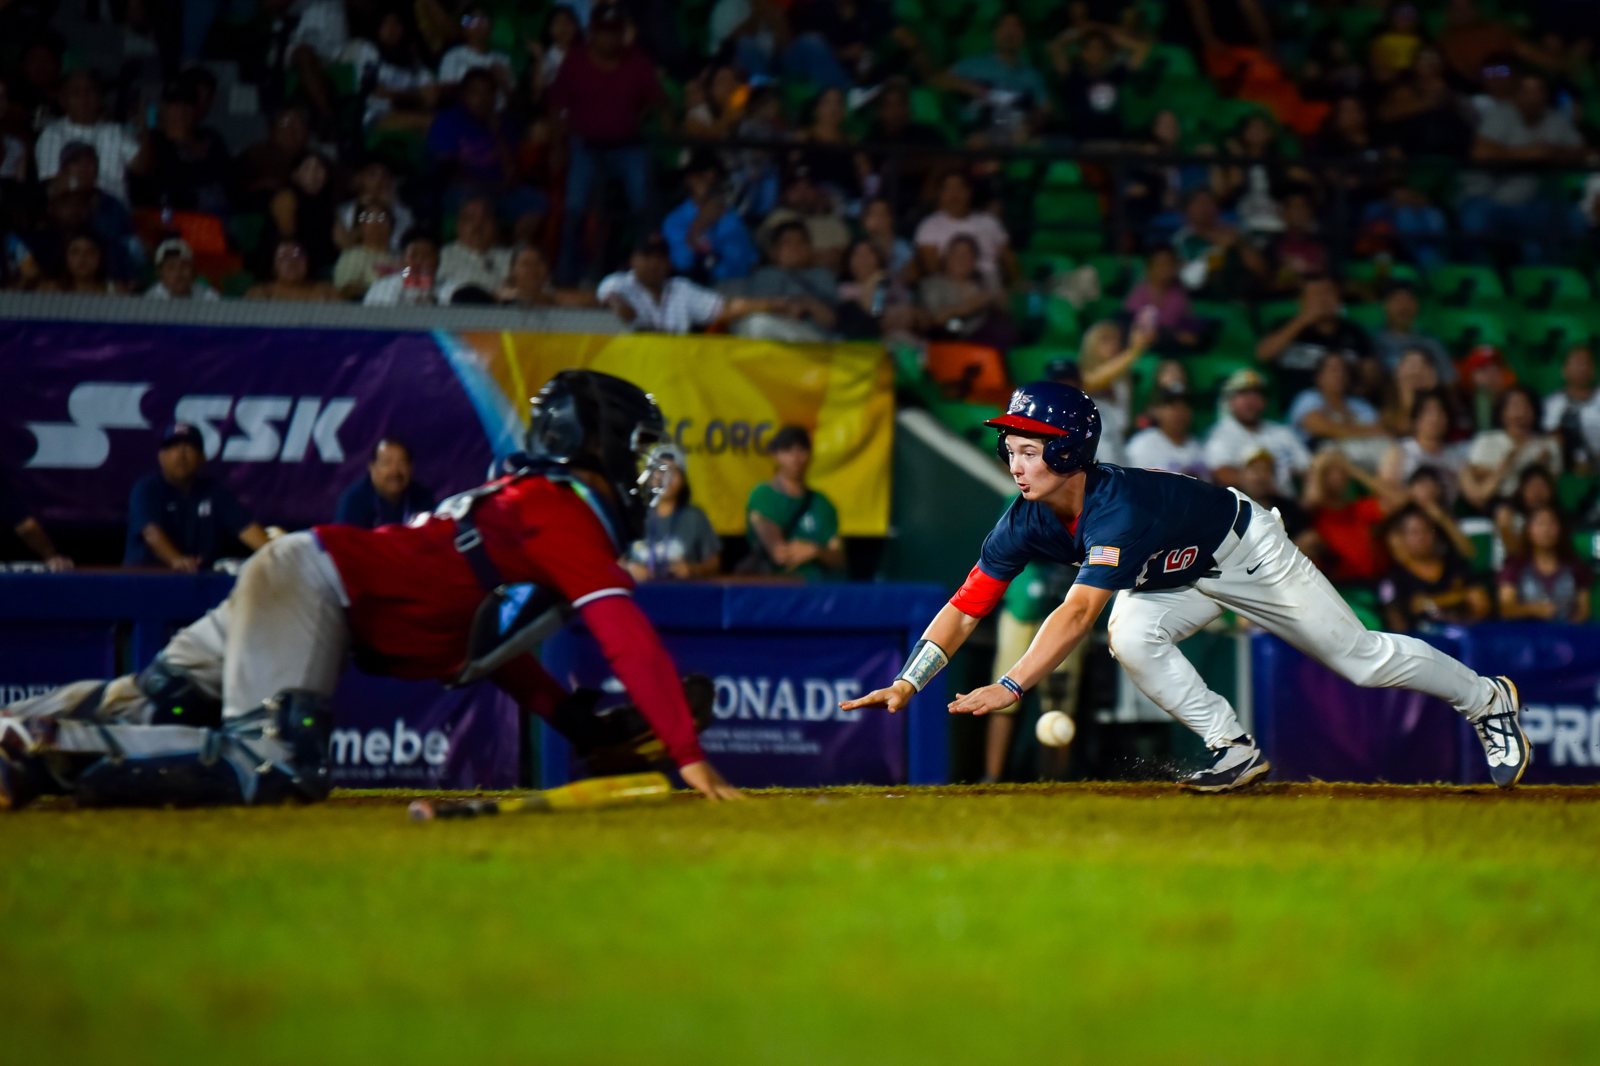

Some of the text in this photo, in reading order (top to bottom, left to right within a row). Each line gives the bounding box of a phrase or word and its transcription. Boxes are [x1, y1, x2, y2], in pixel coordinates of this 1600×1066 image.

[175, 394, 357, 462] SSK
[664, 418, 774, 456] C.ORG
[712, 676, 862, 721] ONADE
[329, 718, 450, 765] mebe
